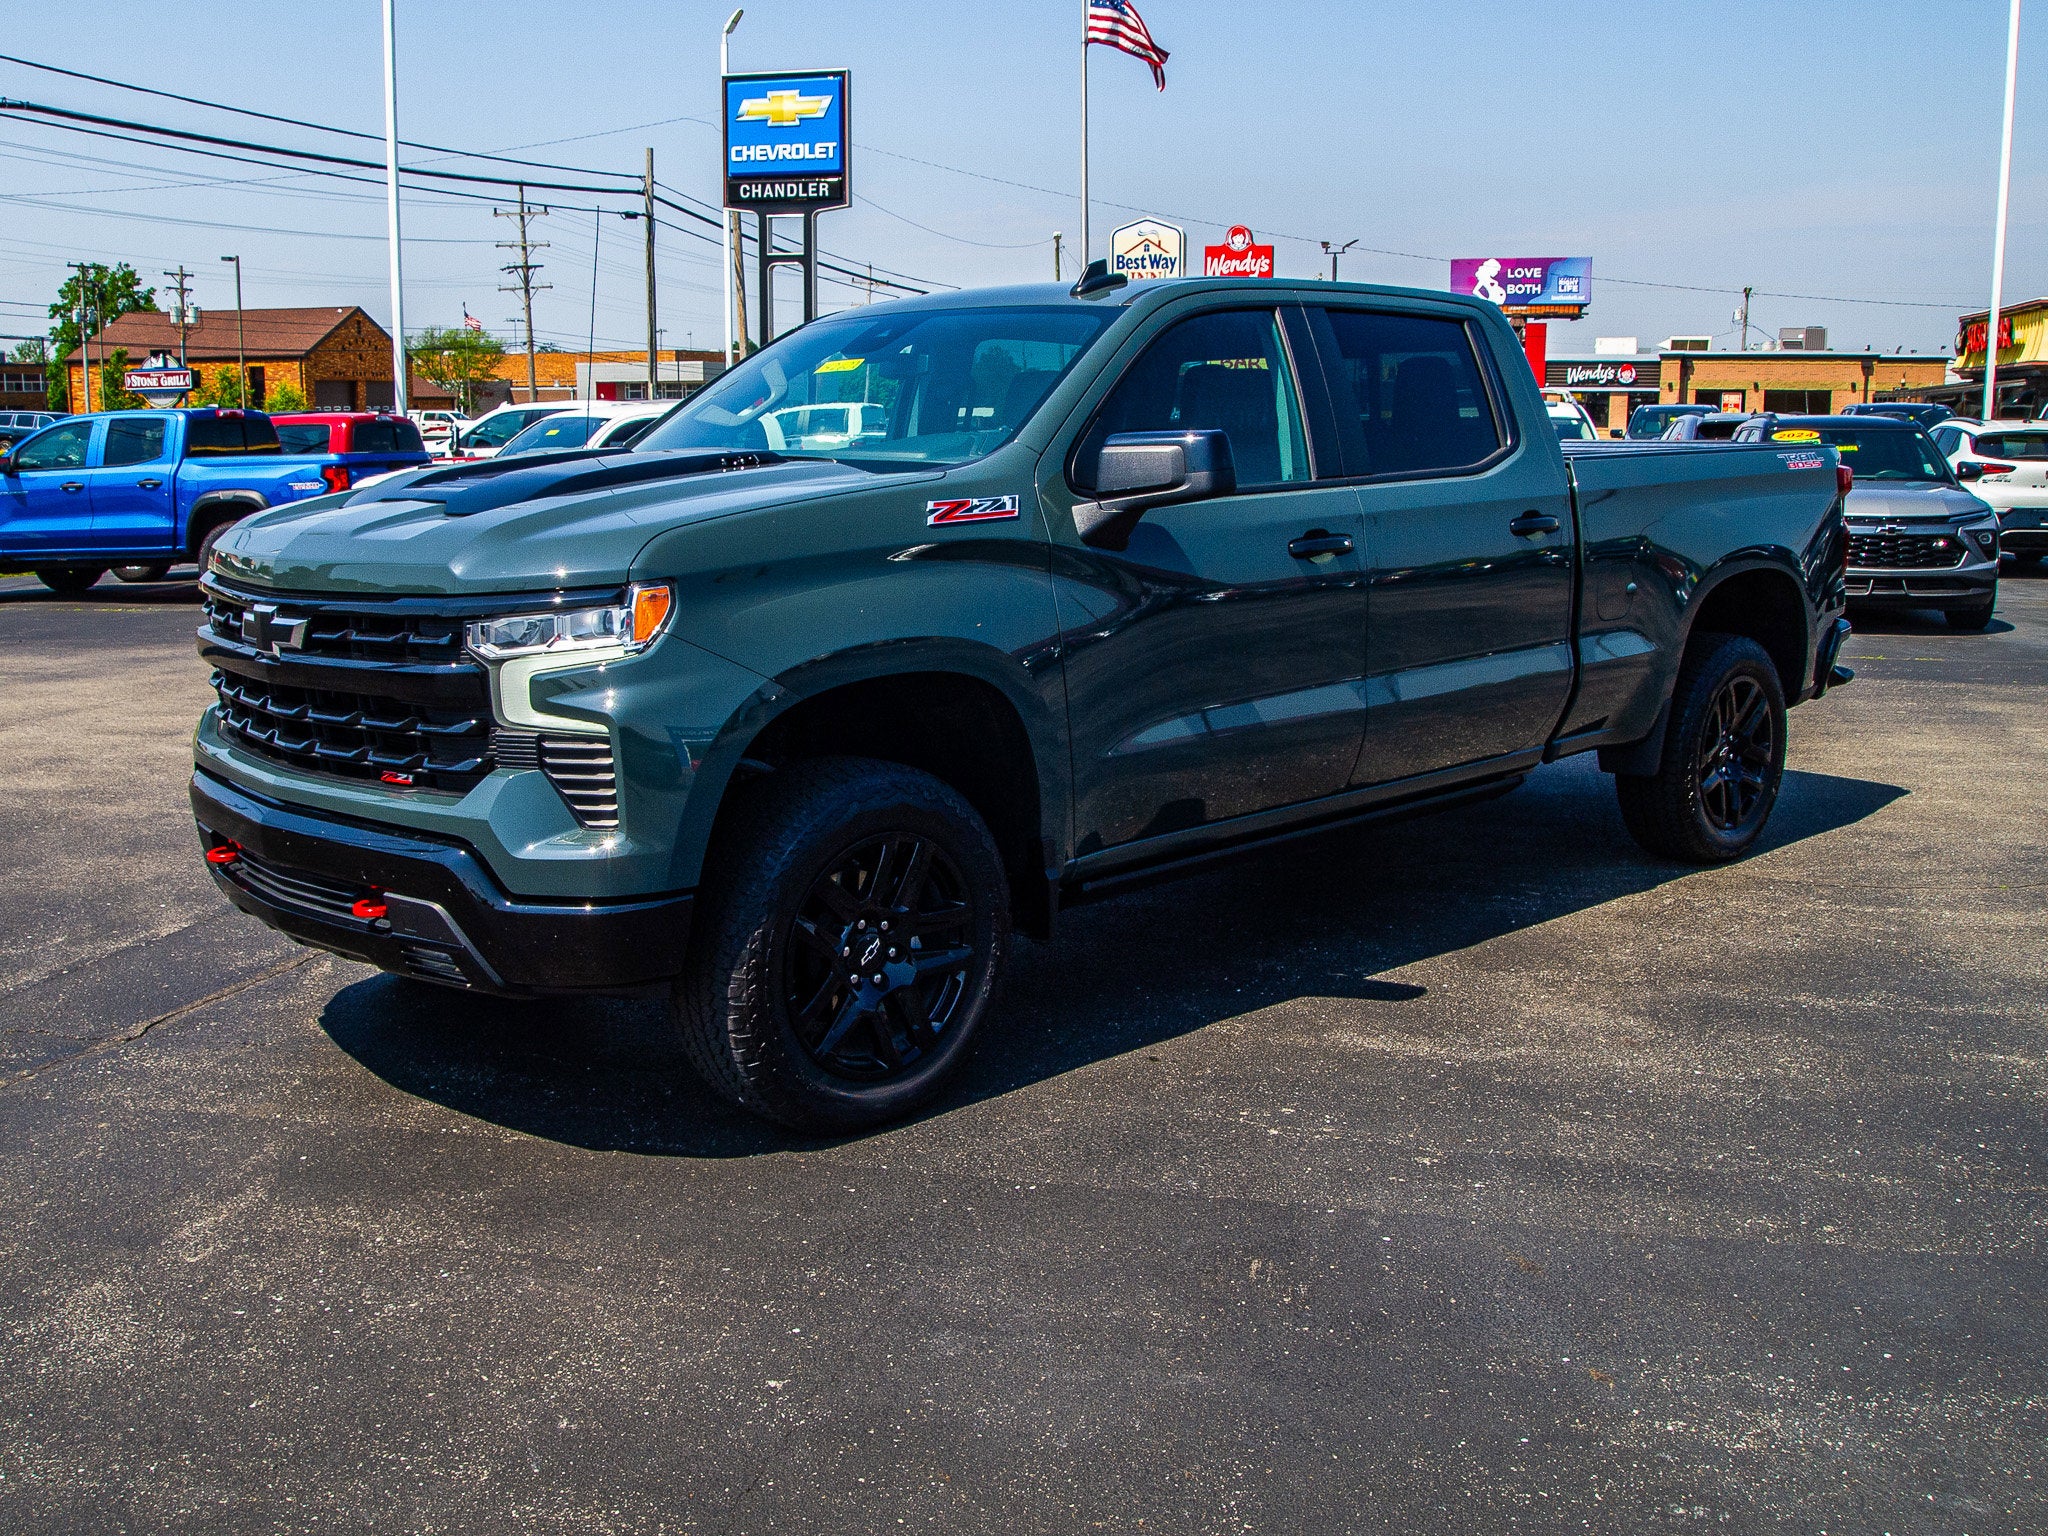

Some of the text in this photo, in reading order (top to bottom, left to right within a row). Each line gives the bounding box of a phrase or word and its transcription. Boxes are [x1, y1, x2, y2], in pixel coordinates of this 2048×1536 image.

[731, 142, 837, 162] CHEVROLET
[740, 183, 829, 198] CHANDLER
[1116, 254, 1177, 274] Best Way
[1206, 251, 1270, 278] Wendy's
[1507, 267, 1542, 279] LOVE
[1506, 283, 1542, 295] BOTH
[1558, 285, 1579, 293] LIFE
[130, 374, 186, 387] STONE GRILL
[1567, 363, 1615, 385] Wendy's
[1778, 431, 1814, 439] 2024
[1776, 452, 1825, 464] TRAIL
[1787, 460, 1823, 470] BOSS
[926, 495, 1019, 526] Z71
